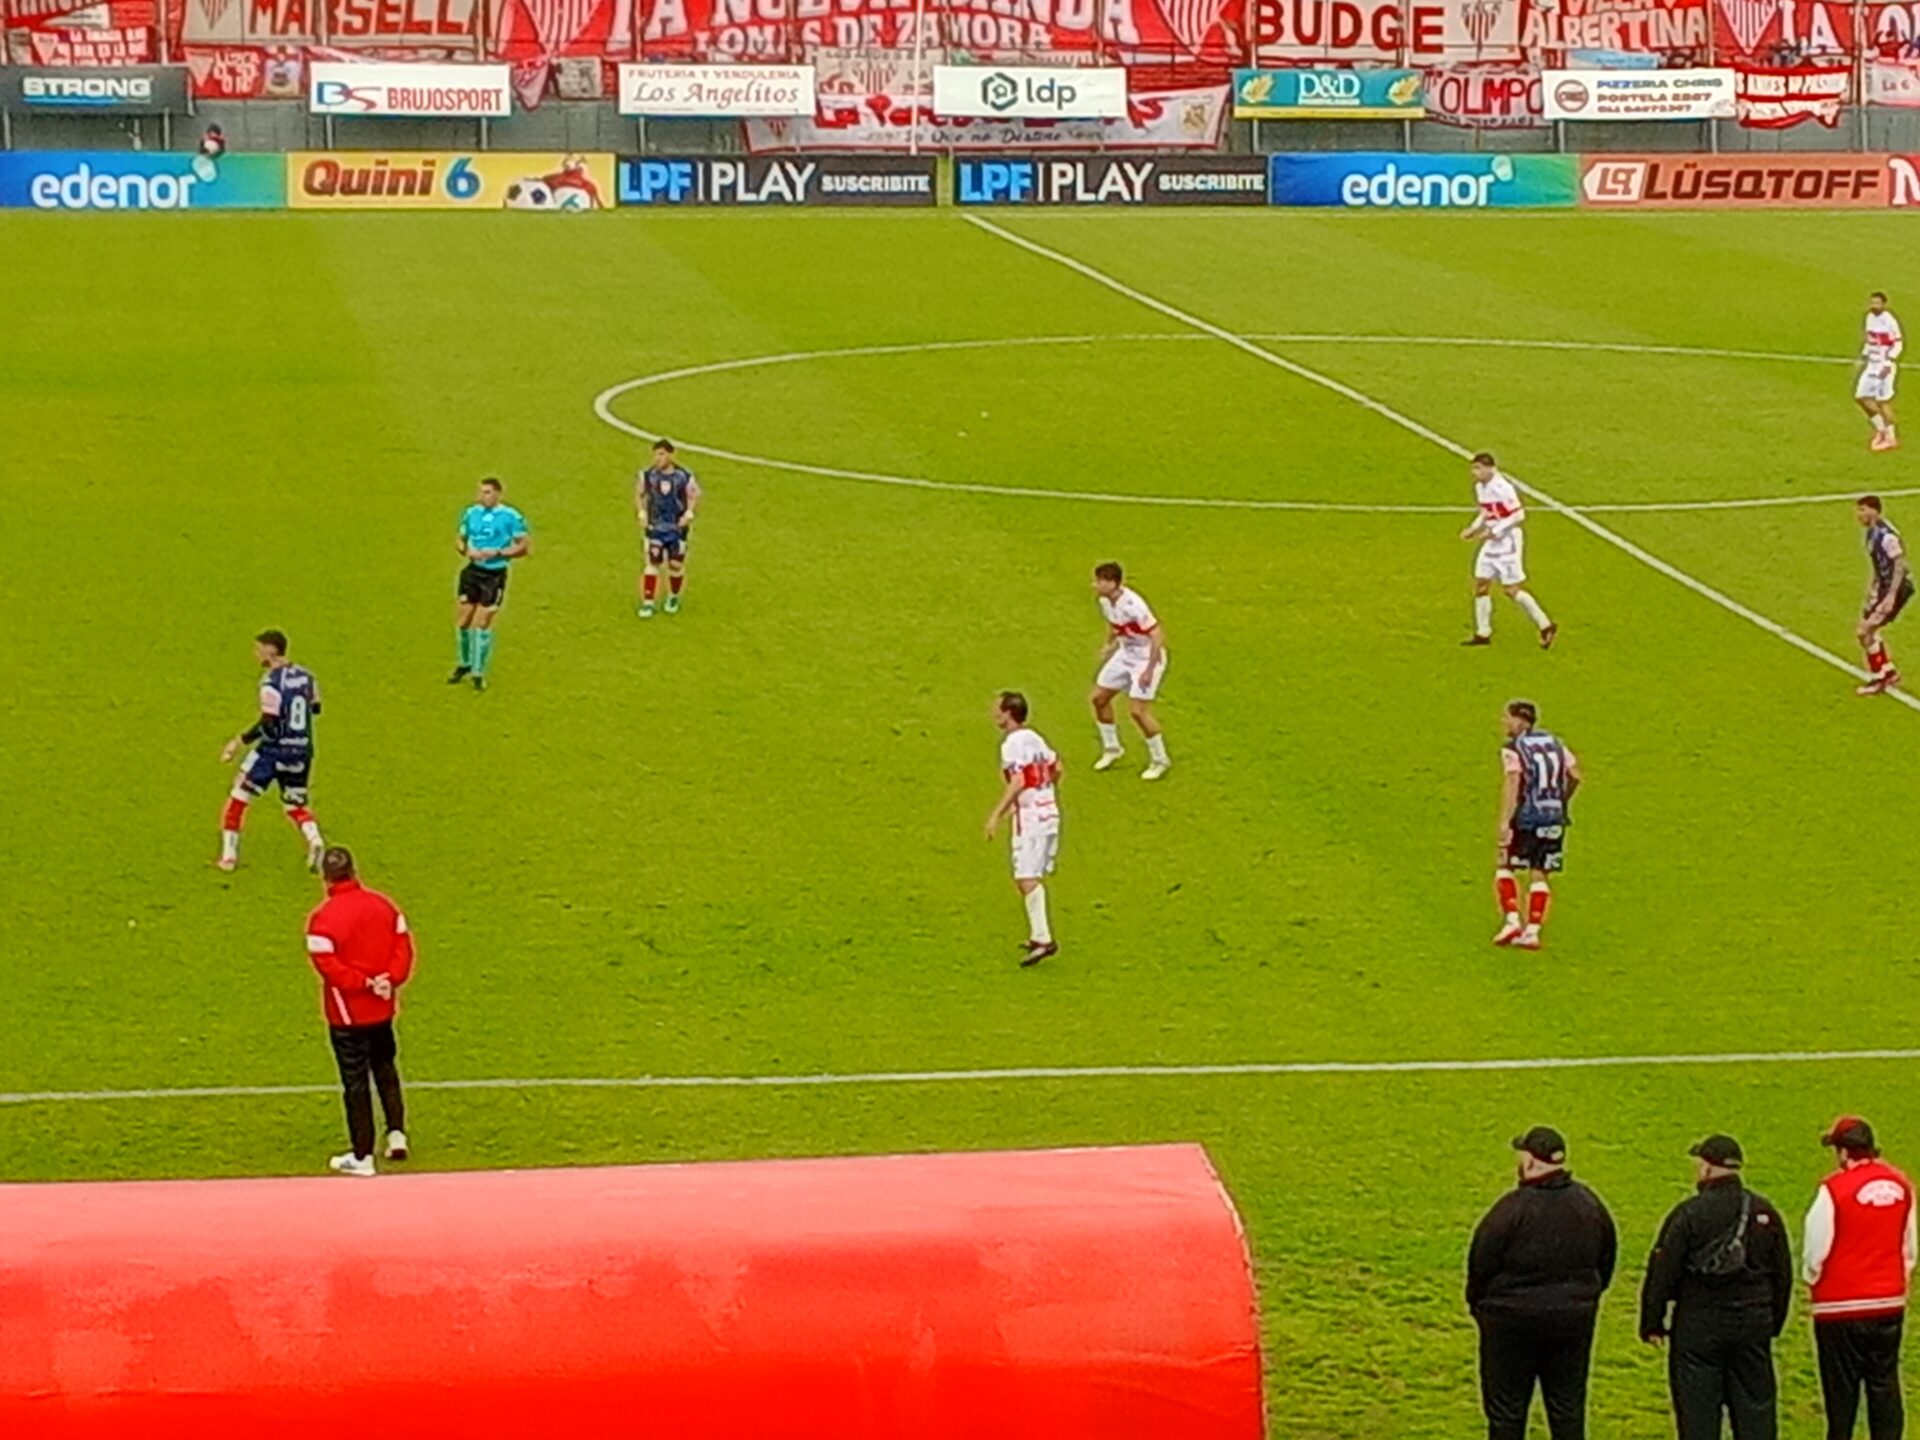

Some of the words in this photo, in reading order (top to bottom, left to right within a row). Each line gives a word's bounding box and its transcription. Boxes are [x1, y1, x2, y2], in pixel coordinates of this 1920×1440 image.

[694, 20, 823, 54] LOMS
[833, 16, 885, 48] DE
[1257, 0, 1444, 53] BUDGE
[1520, 8, 1707, 50] ALBERTINA
[22, 77, 152, 97] STRONG
[386, 87, 504, 111] BRUJOSPORT
[633, 81, 678, 103] Los
[682, 79, 801, 110] Angelitos
[1025, 77, 1078, 111] ldp
[1298, 73, 1362, 98] D&D
[31, 162, 198, 209] edenor
[302, 158, 437, 197] Quini
[445, 157, 481, 200] 6
[618, 163, 692, 203] LPF
[710, 161, 816, 202] PLAY
[820, 173, 931, 193] SUSCRIBITE
[959, 163, 1032, 203] LPF
[1050, 161, 1154, 202] PLAY
[1158, 172, 1266, 192] SUSCRIBITE
[1342, 162, 1496, 207] edenor
[289, 694, 307, 731] 8
